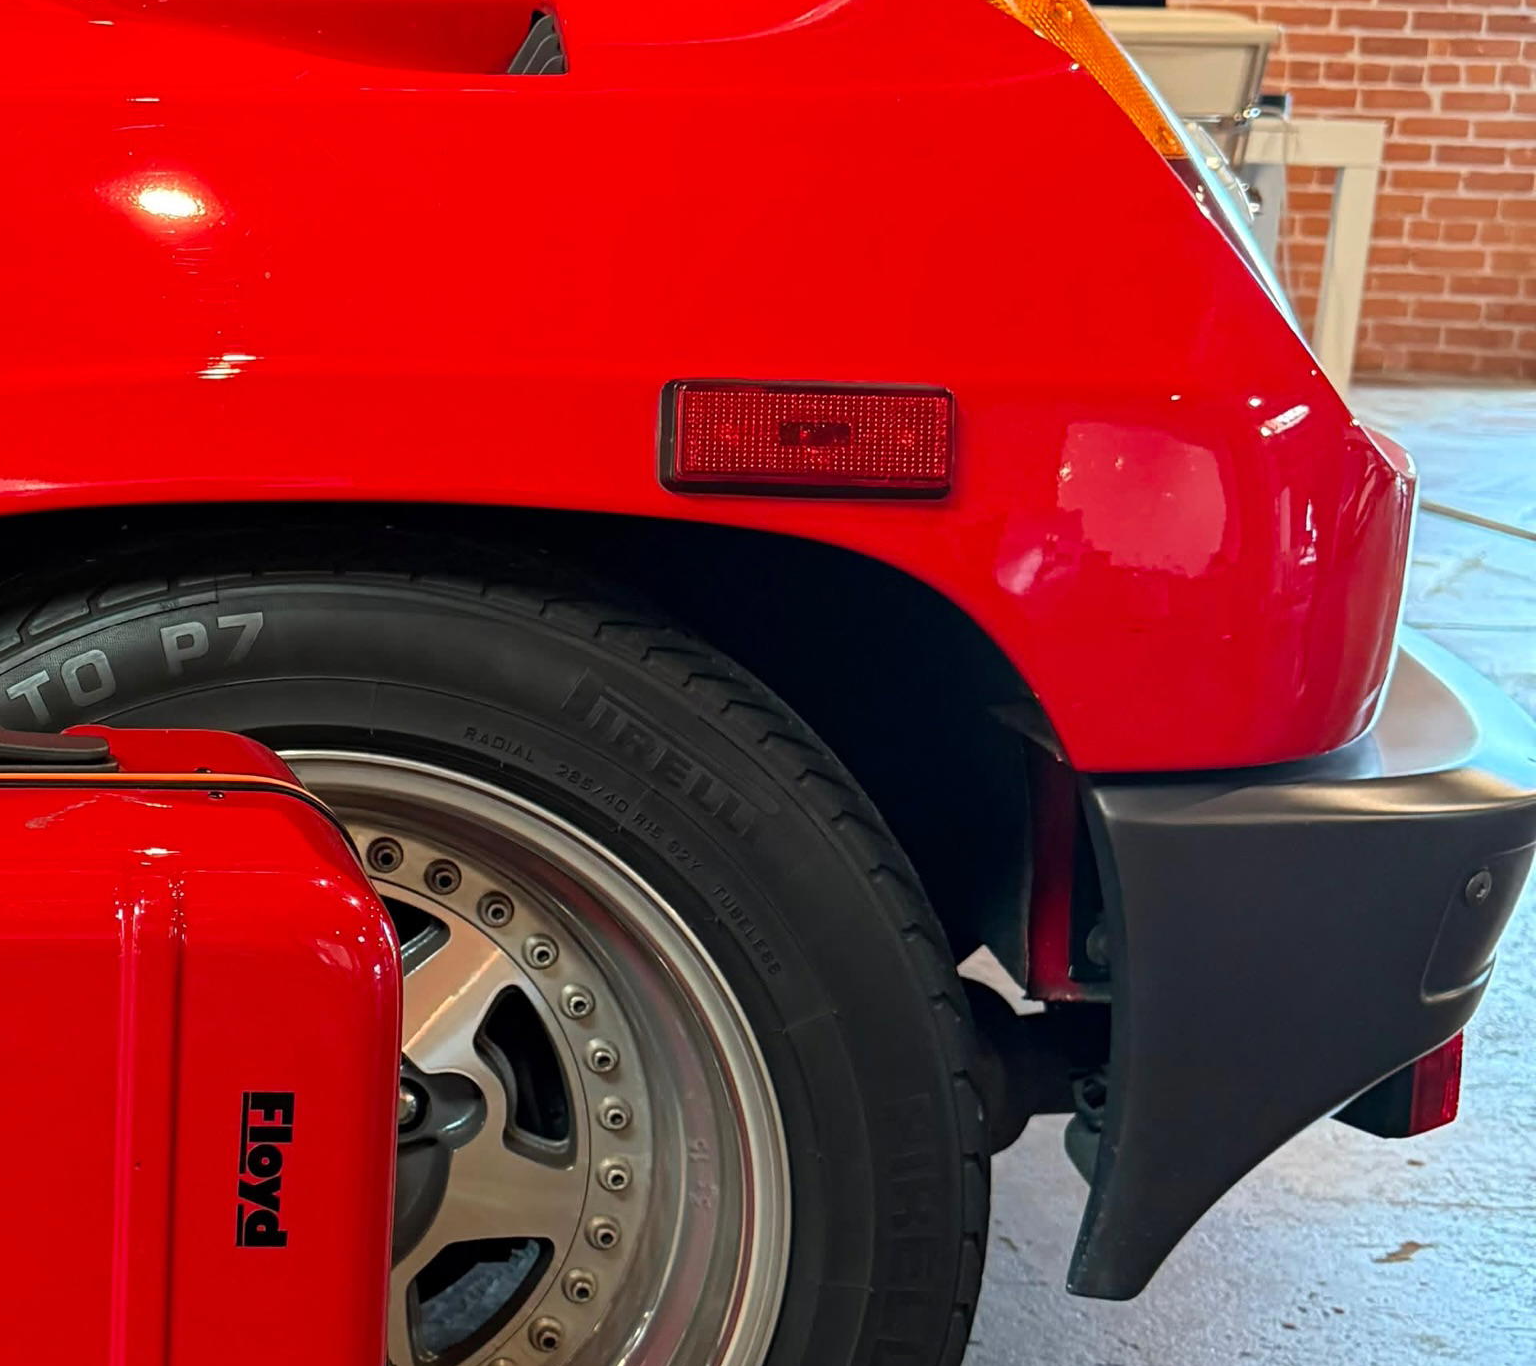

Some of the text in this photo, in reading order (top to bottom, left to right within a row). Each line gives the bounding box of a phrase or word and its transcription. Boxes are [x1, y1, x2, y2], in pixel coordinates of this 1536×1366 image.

[159, 611, 264, 676] P7
[464, 726, 535, 763] RADIAL
[235, 1090, 295, 1248] Floyd
